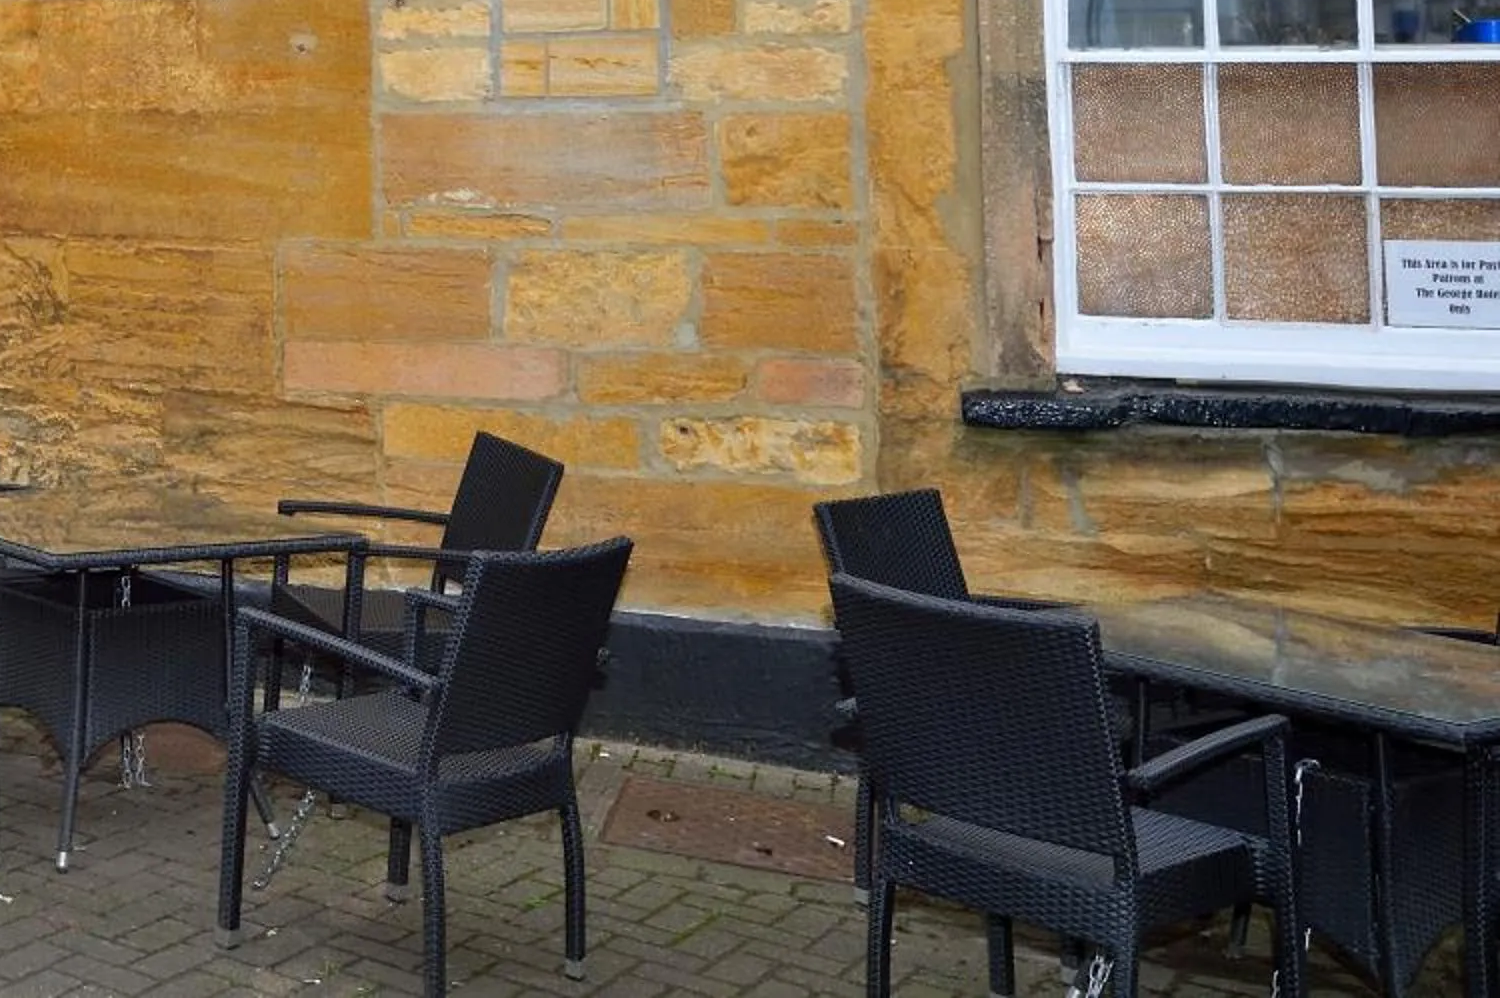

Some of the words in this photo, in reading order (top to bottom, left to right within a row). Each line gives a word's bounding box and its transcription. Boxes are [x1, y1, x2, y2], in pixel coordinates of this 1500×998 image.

[1424, 259, 1448, 269] Area
[1461, 259, 1476, 270] for
[1416, 288, 1435, 299] The
[1437, 288, 1472, 300] George
